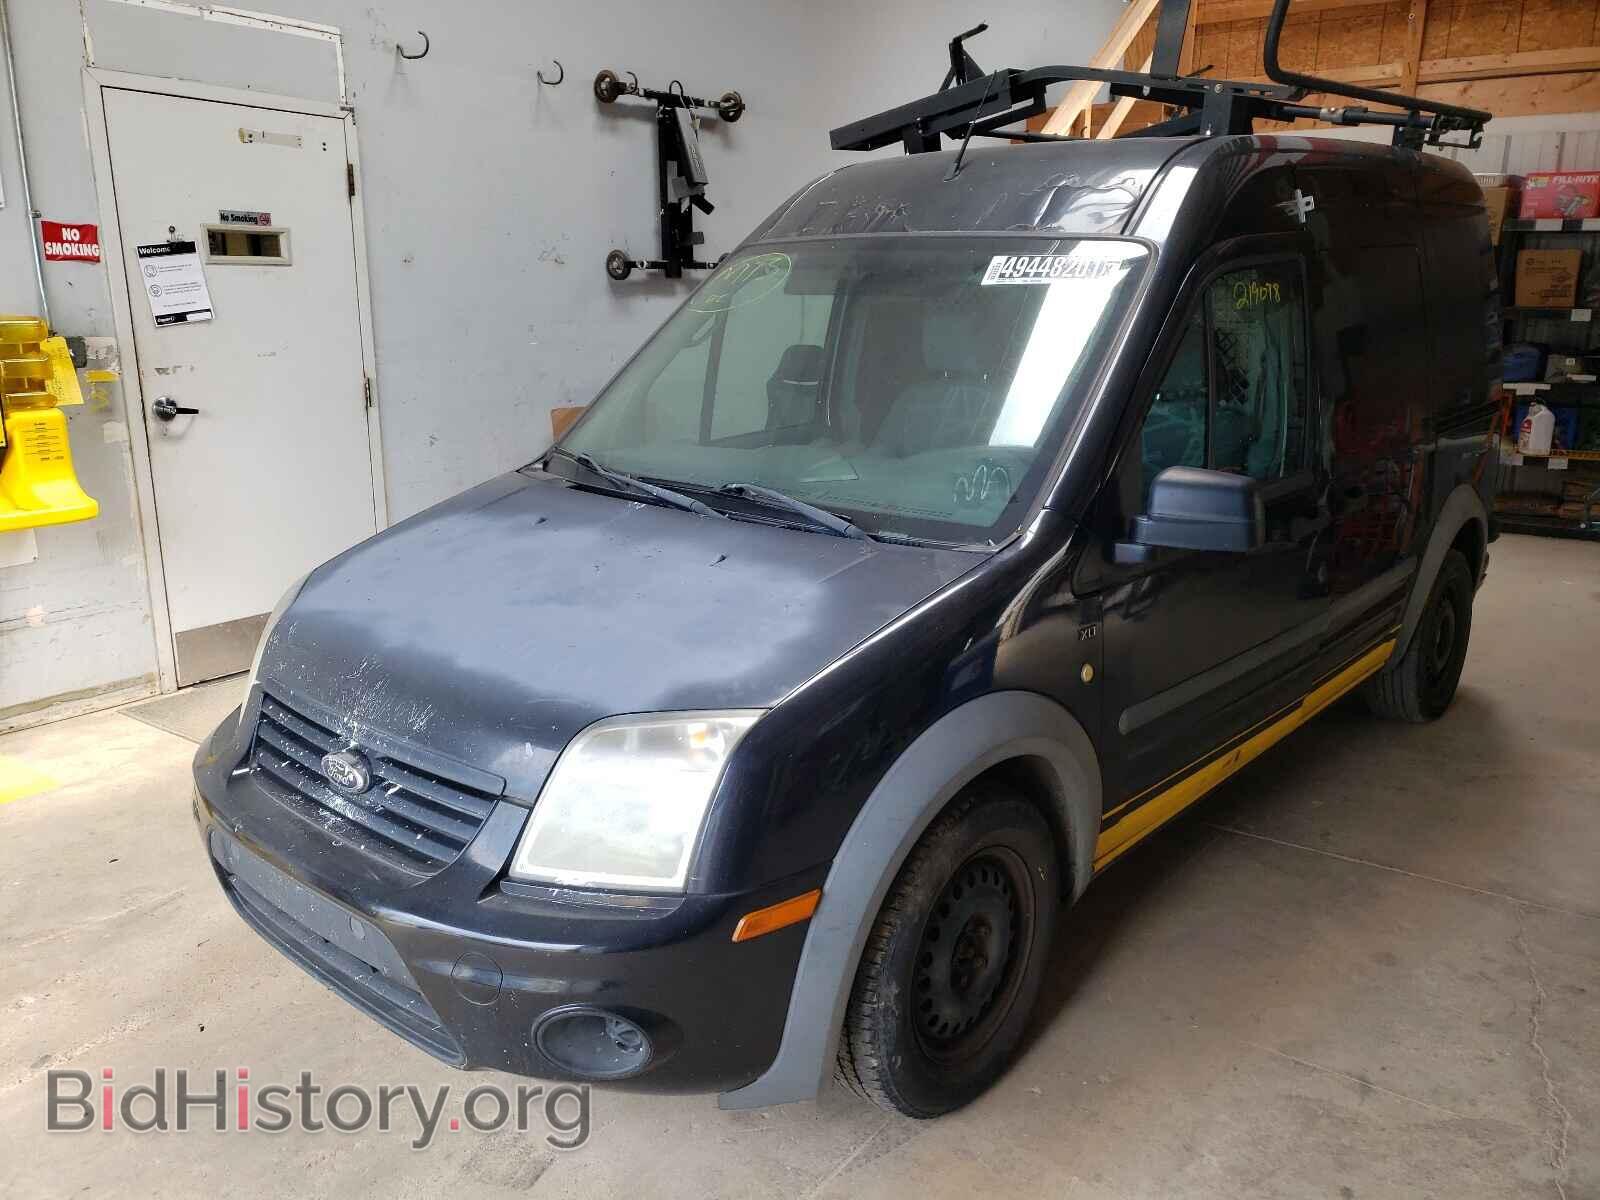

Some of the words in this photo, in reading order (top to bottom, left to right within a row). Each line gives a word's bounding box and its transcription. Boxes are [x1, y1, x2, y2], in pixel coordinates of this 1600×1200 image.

[220, 212, 230, 223] No
[231, 213, 258, 225] Smoking
[61, 227, 80, 241] NO
[45, 241, 100, 257] SMOKING
